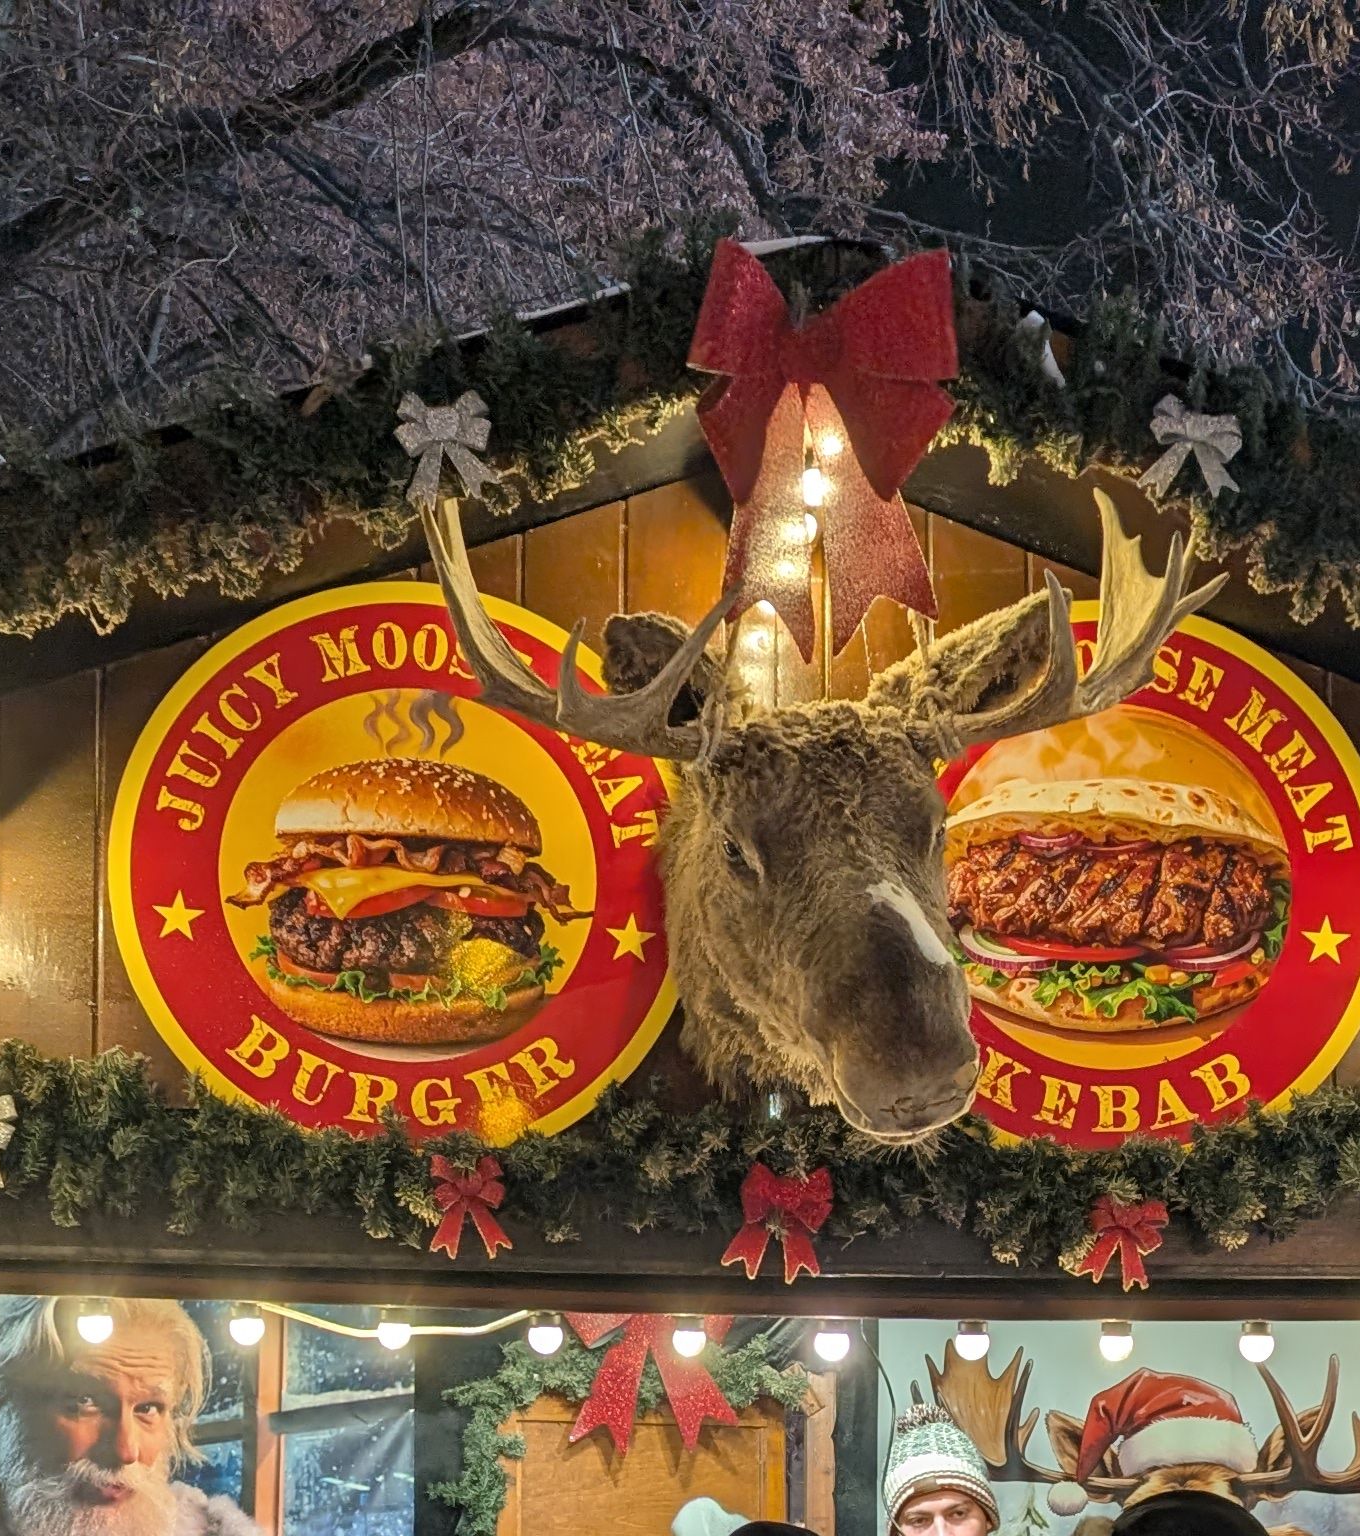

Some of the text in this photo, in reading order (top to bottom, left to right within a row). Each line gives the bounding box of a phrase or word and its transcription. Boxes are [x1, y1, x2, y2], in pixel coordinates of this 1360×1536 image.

[155, 652, 300, 832] JUICY
[1224, 686, 1355, 855] MEAT
[976, 1046, 1253, 1134] KEBAB
